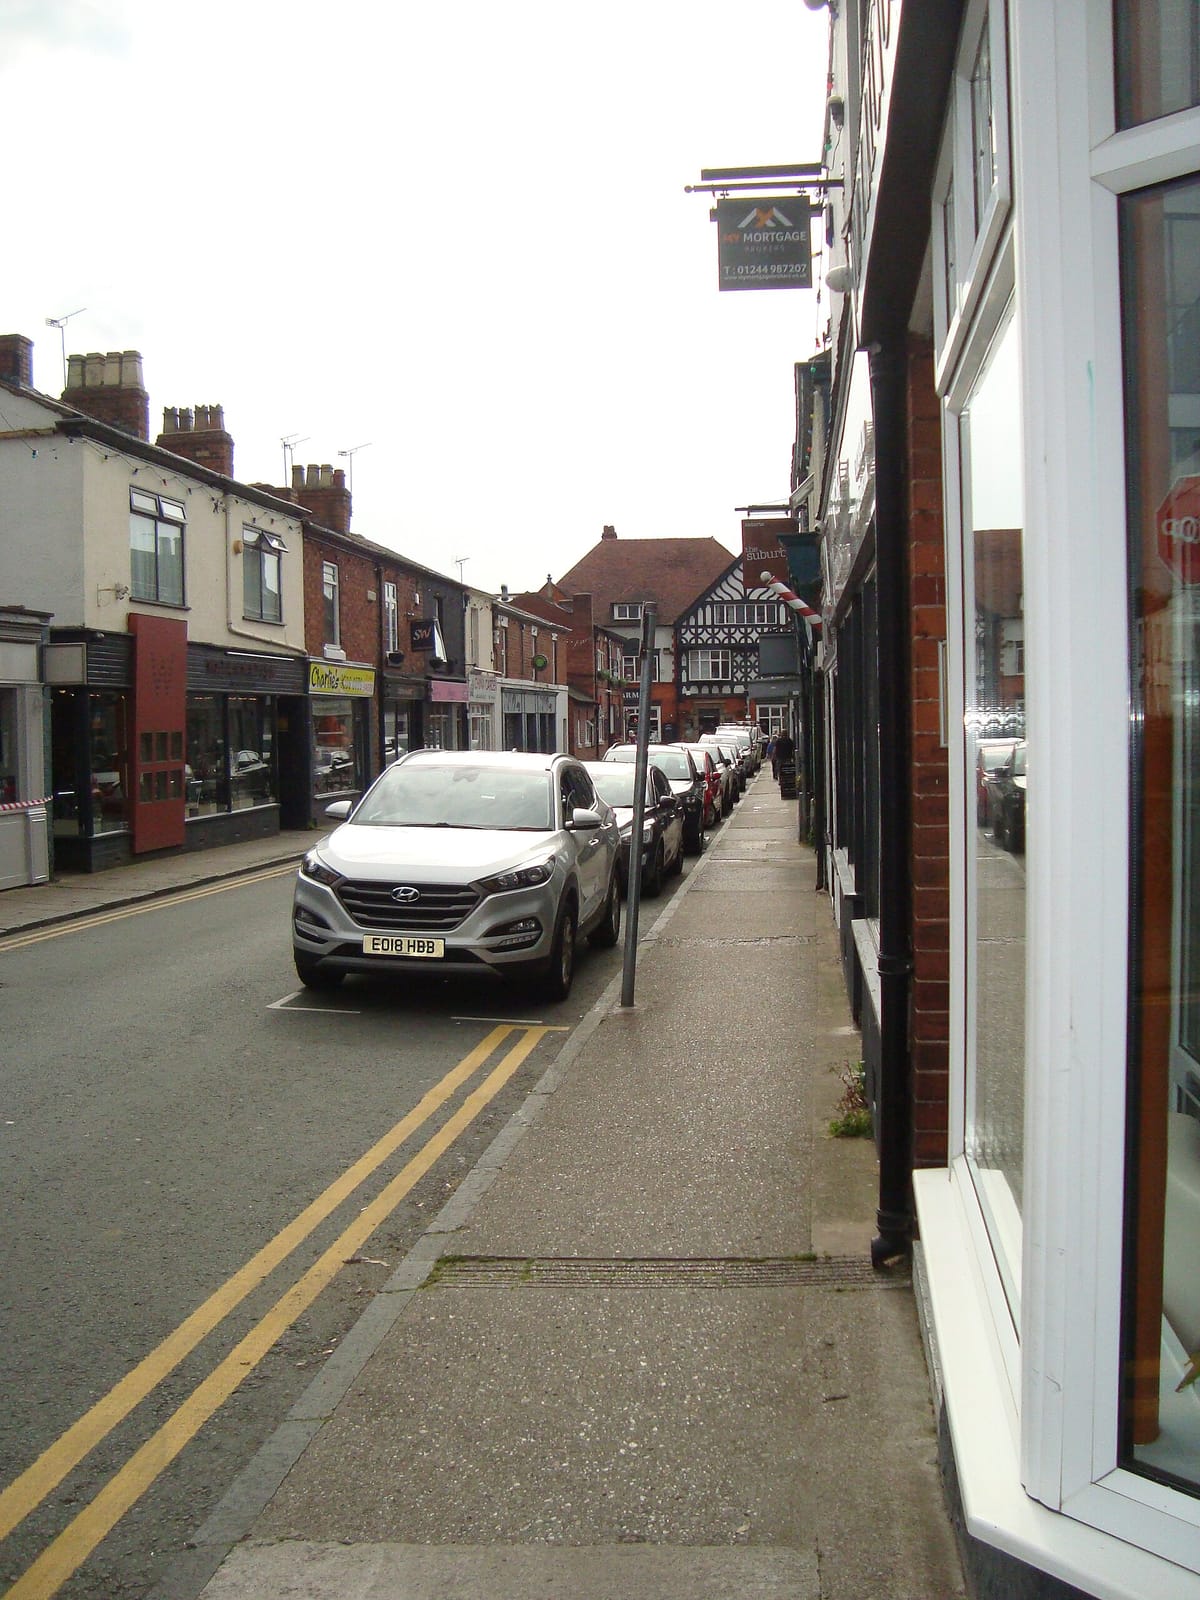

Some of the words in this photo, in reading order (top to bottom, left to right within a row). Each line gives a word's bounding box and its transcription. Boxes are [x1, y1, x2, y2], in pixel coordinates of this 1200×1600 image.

[743, 231, 807, 243] MORTGAGE
[737, 265, 769, 275] 01244
[770, 263, 808, 273] 987207
[407, 940, 435, 954] HBB
